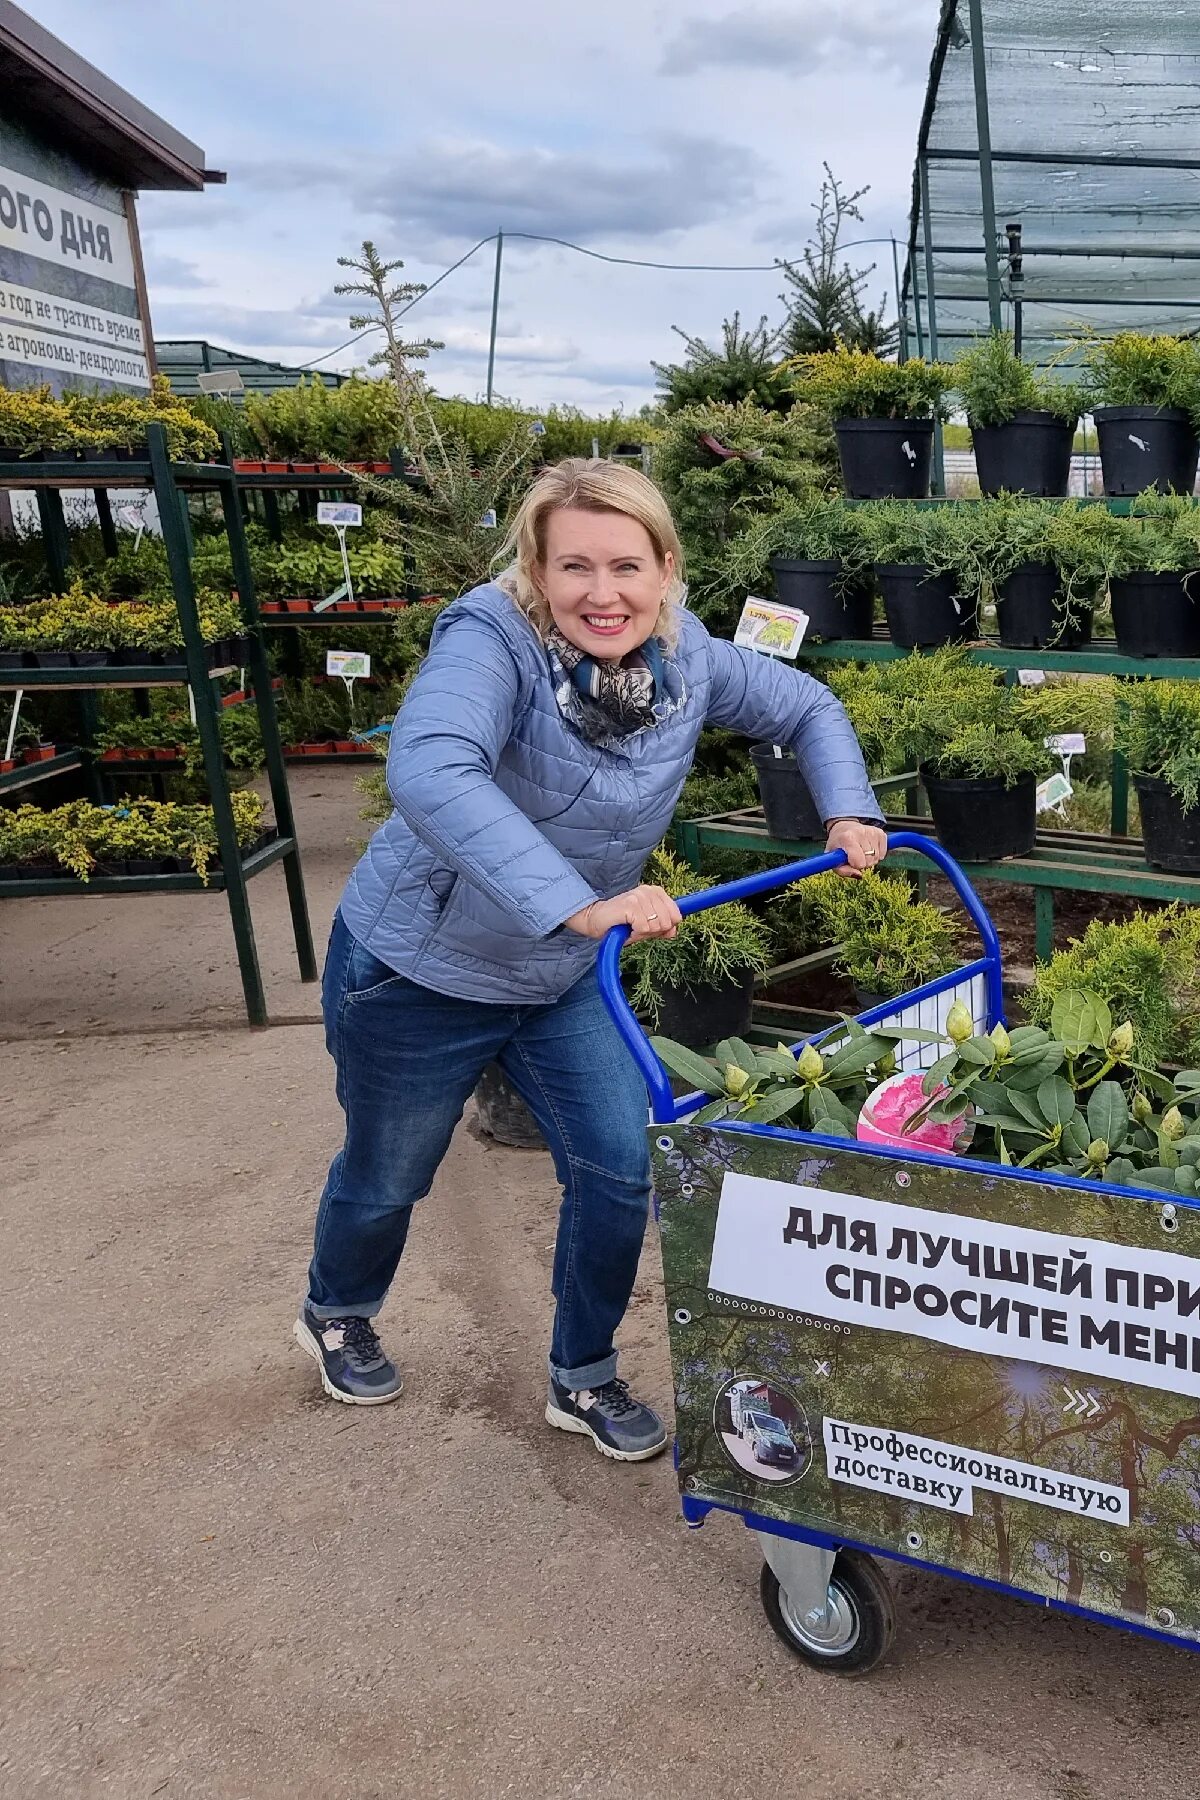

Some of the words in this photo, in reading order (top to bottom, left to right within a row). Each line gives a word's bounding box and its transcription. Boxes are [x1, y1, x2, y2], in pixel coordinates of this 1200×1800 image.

[60, 208, 113, 264] ДНЯ
[10, 294, 33, 319] год
[35, 300, 51, 318] не
[53, 305, 104, 334] тратить
[107, 319, 141, 343] время
[7, 333, 148, 380] агрономы-дендрологи.
[783, 1207, 877, 1256] ДЛЯ
[887, 1228, 1093, 1299] ЛУЧШЕЙ
[825, 1264, 1069, 1346] СПРОСИТЕ
[830, 1423, 1122, 1514] Профессиональную
[834, 1455, 964, 1507] доставку
